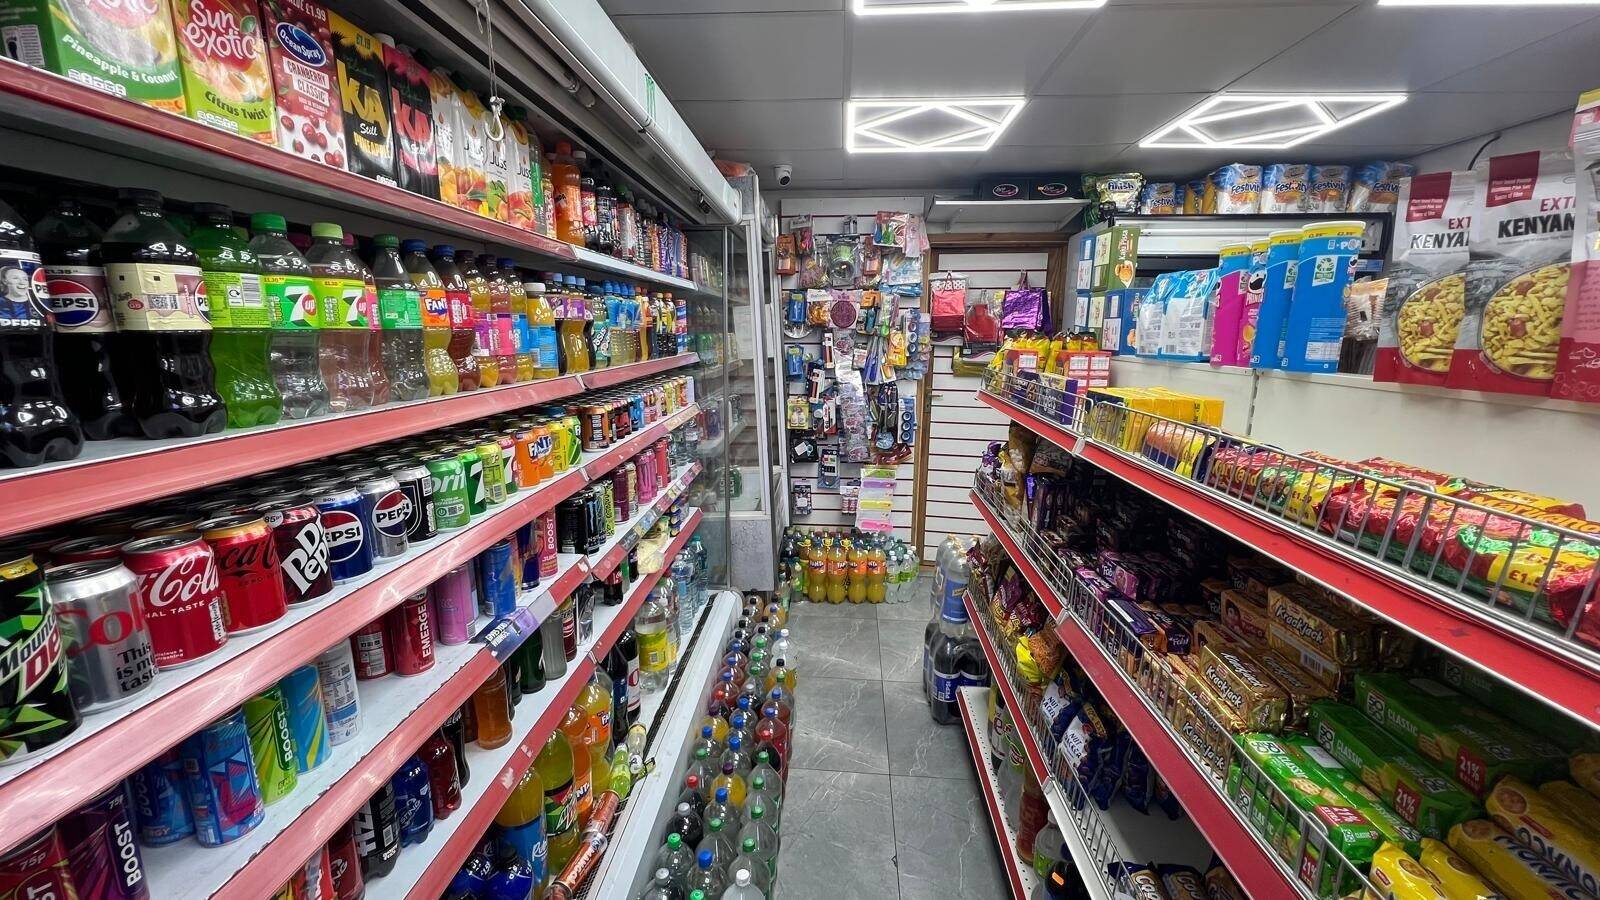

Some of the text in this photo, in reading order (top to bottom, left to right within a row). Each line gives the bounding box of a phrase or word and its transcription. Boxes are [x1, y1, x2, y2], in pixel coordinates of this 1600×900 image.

[305, 3, 326, 22] £1.99
[184, 2, 257, 60] Sun exotic
[280, 29, 321, 60] Ocean Spray
[62, 34, 178, 84] Pineapple & Coconut
[287, 60, 328, 86] CRANBERRY
[297, 79, 326, 103] CLASSIC
[336, 59, 389, 138] KA
[204, 91, 268, 120] Citrus Twist
[392, 87, 431, 143] KA
[360, 122, 378, 137] Still
[490, 152, 508, 172] Juss
[1107, 181, 1134, 192] finish
[52, 298, 95, 309] EPSI
[547, 518, 555, 550] BOOST
[1508, 570, 1541, 588] £1.5
[170, 600, 206, 616] TASTE
[418, 603, 431, 658] EMERGE
[1275, 604, 1323, 645] Krackjack
[116, 666, 134, 681] is
[1205, 664, 1243, 709] Krackjack
[1387, 708, 1418, 736] CLASSIC
[277, 711, 293, 762] BOOST
[1070, 732, 1083, 746] NUT
[1337, 740, 1363, 769] CLASSIC
[1460, 756, 1480, 780] 21%
[1397, 788, 1416, 814] 21%
[20, 852, 46, 871] 75P
[114, 821, 141, 887] BOOST
